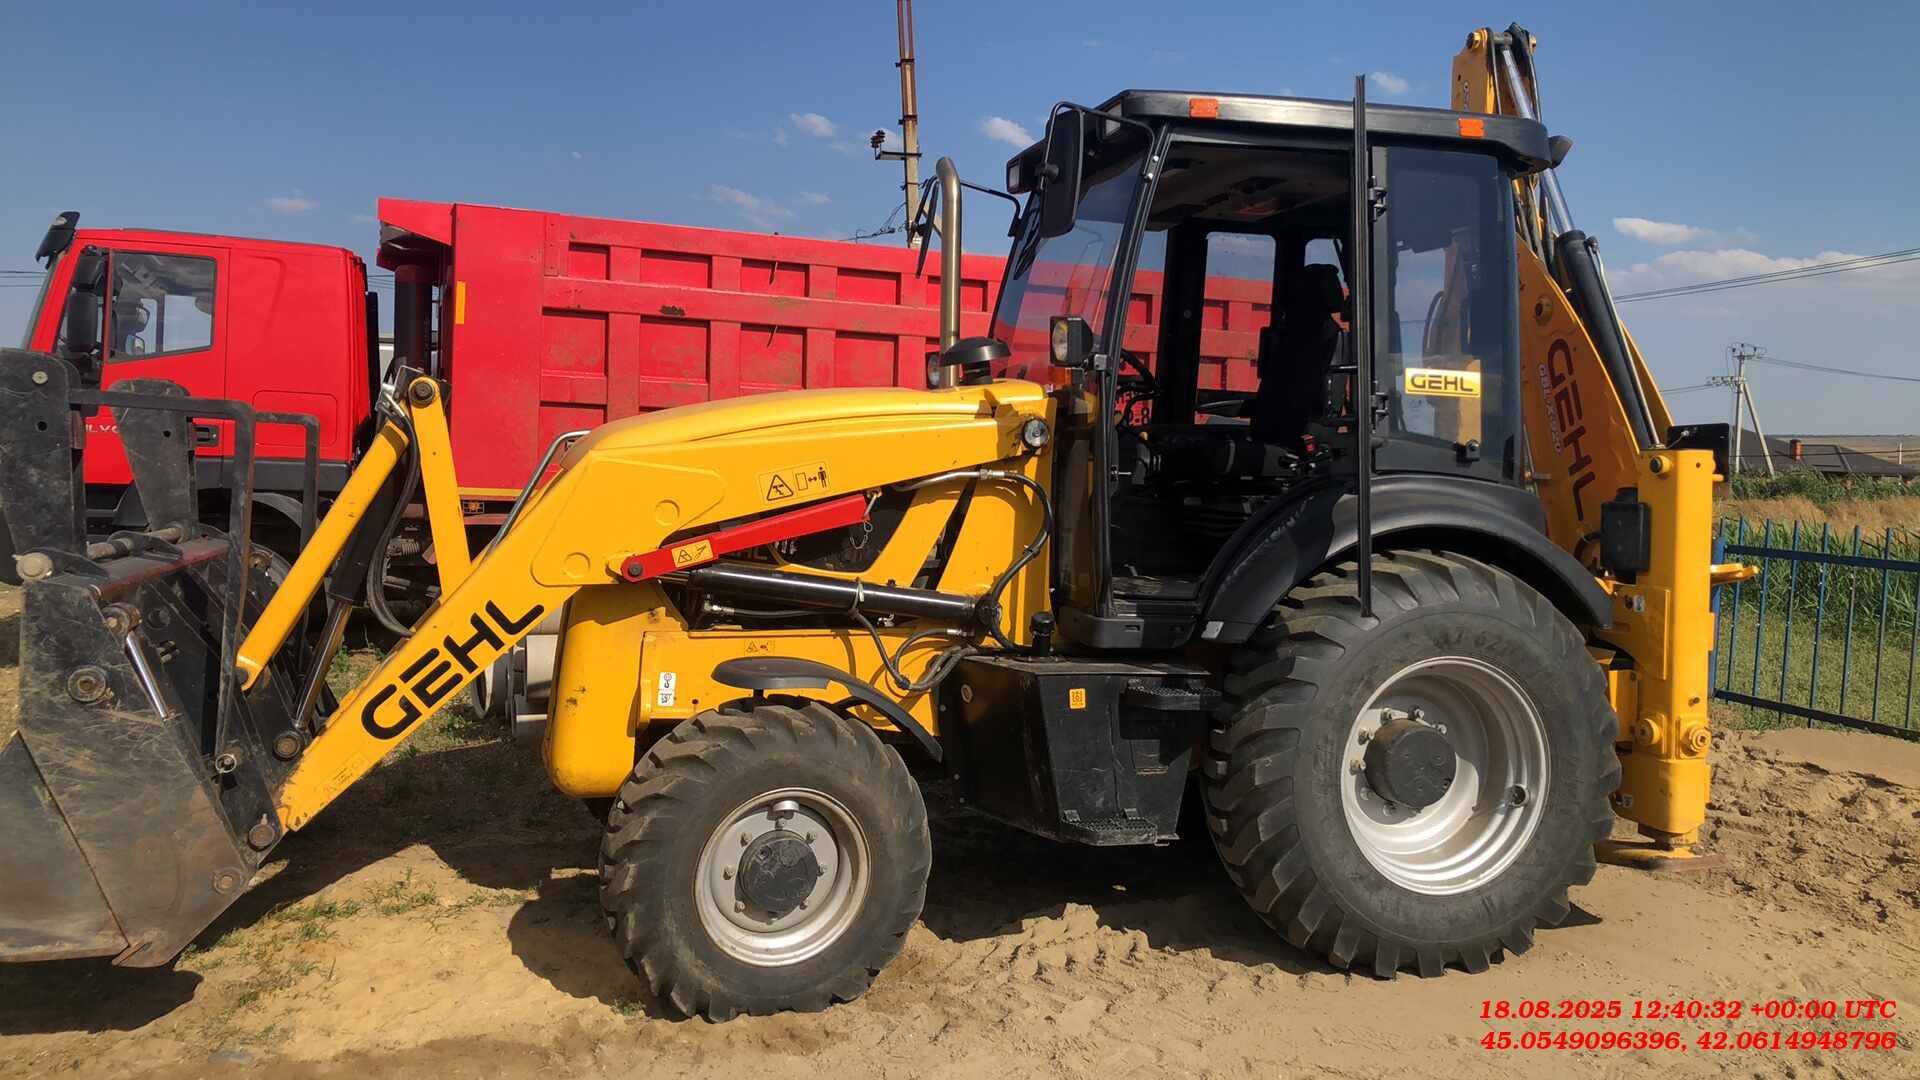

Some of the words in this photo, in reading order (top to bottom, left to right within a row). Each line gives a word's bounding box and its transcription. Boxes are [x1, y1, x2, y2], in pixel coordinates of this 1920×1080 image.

[1410, 373, 1474, 392] GEHL
[1547, 338, 1596, 521] GEHL
[361, 600, 545, 740] GEHL
